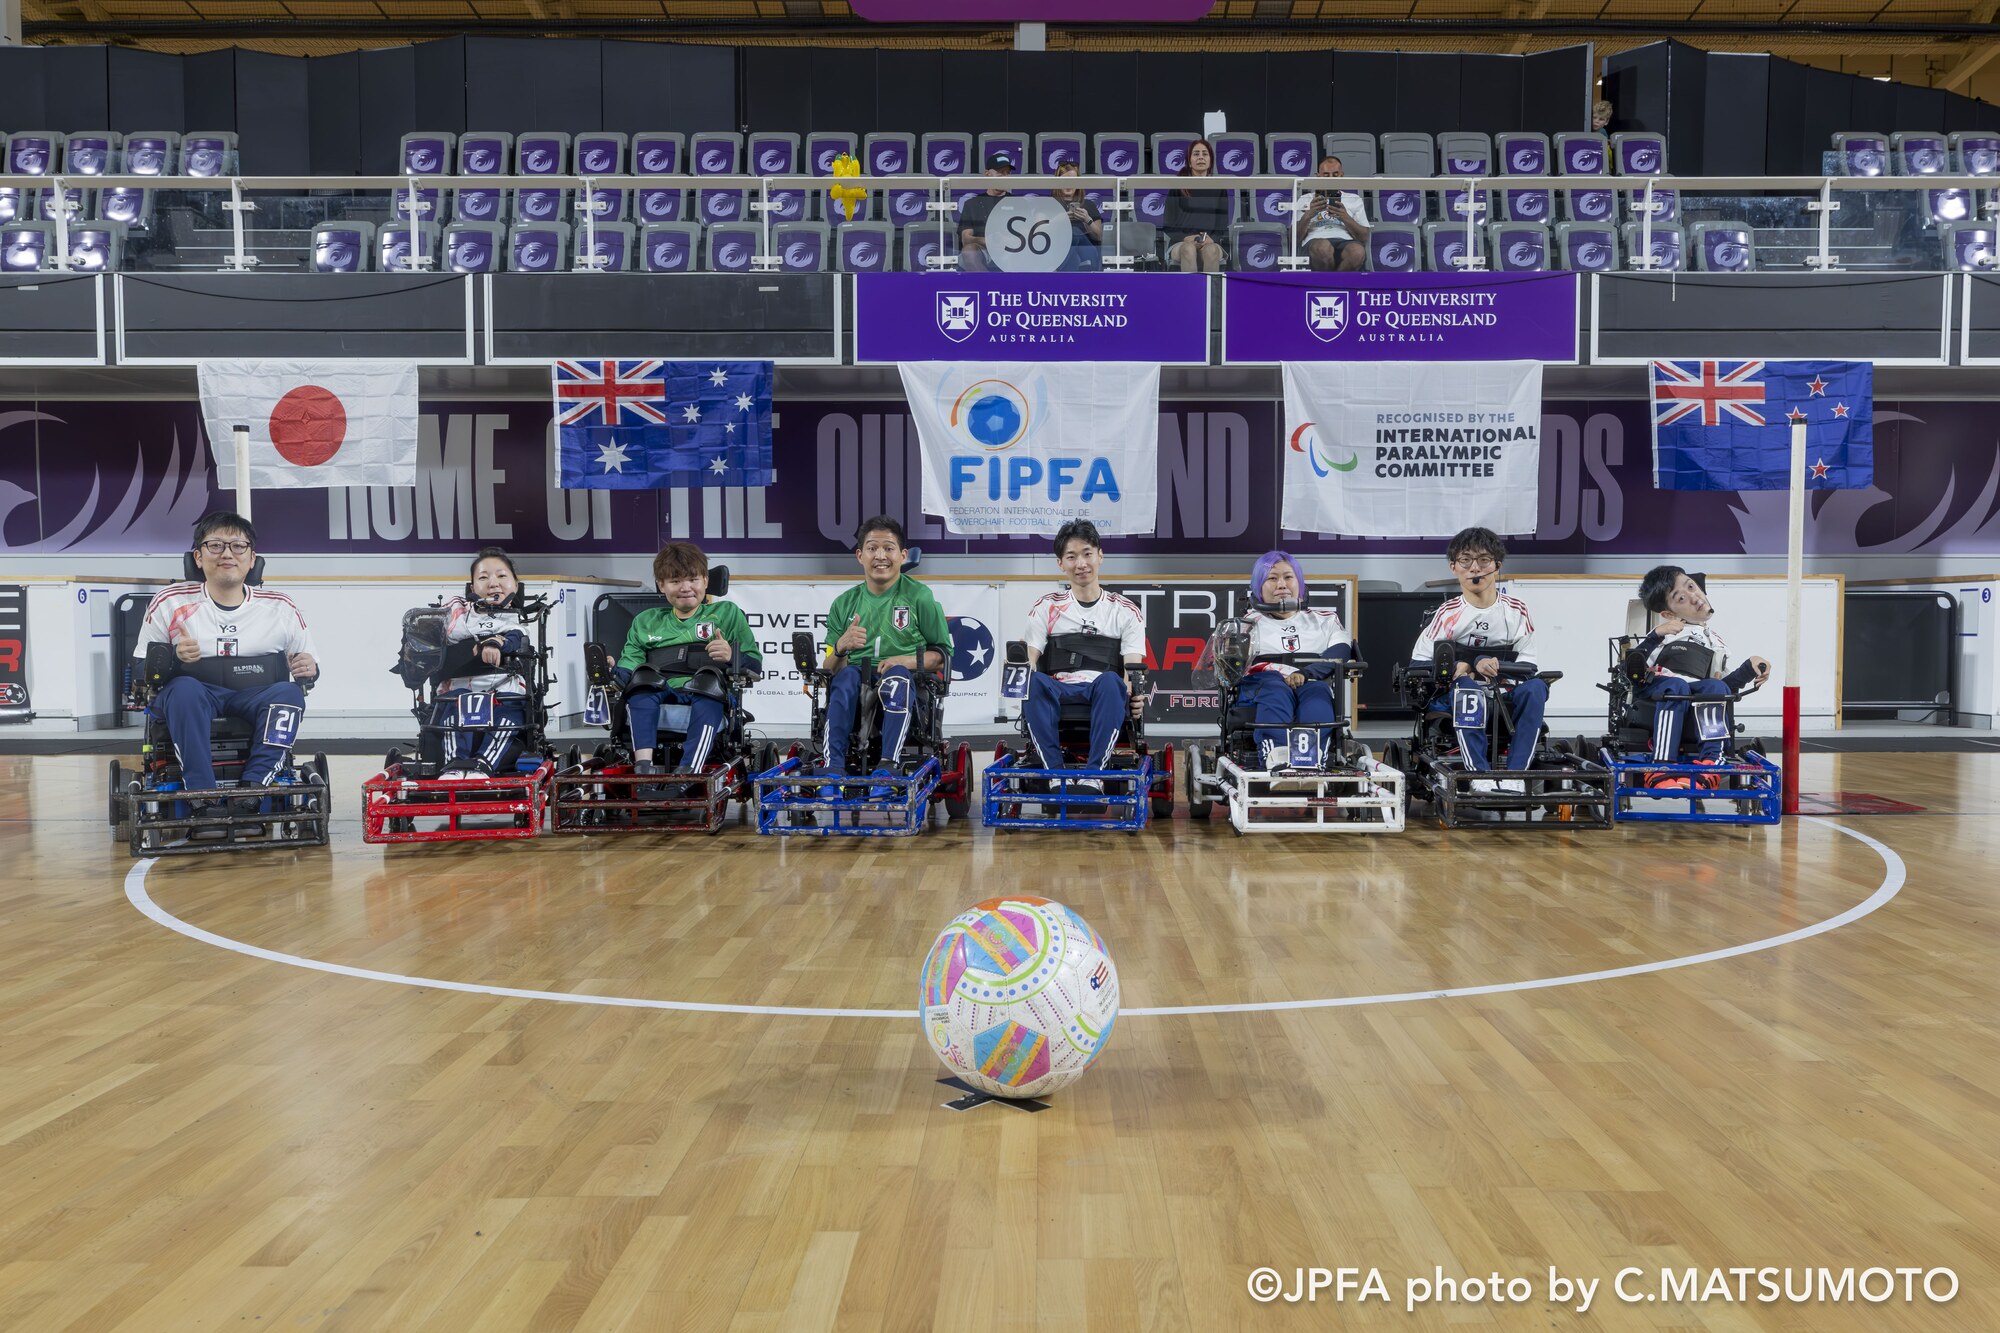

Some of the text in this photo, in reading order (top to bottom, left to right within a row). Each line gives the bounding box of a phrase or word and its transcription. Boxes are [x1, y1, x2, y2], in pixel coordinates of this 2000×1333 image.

[1004, 215, 1052, 255] S6
[987, 291, 1128, 308] THE UNIVERSITY
[1356, 290, 1498, 307] THE UNIVERSITY
[987, 311, 1128, 330] OF QUEENSLAND
[1356, 310, 1497, 329] OF QUEENSLAND
[988, 334, 1076, 343] AUSTRALIA
[1358, 333, 1445, 342] AUSTRALIA
[1376, 412, 1516, 424] RECOGNISED BY THE
[1376, 425, 1537, 443] INTERNATIONAL
[1375, 445, 1502, 461] PARALYMPIC
[1374, 462, 1495, 478] COMMITTEE
[949, 456, 1122, 503] FIPFA
[949, 506, 1090, 517] FEDERATION INTERNATIONALE DE
[950, 517, 1005, 526] POWERCHAIR
[1009, 518, 1053, 527] FOOTBALL
[745, 613, 829, 629] OWER
[1006, 666, 1028, 687] 73
[467, 694, 485, 714] 17
[1461, 694, 1479, 715] 13
[275, 710, 295, 733] 21
[1298, 733, 1310, 754] 8
